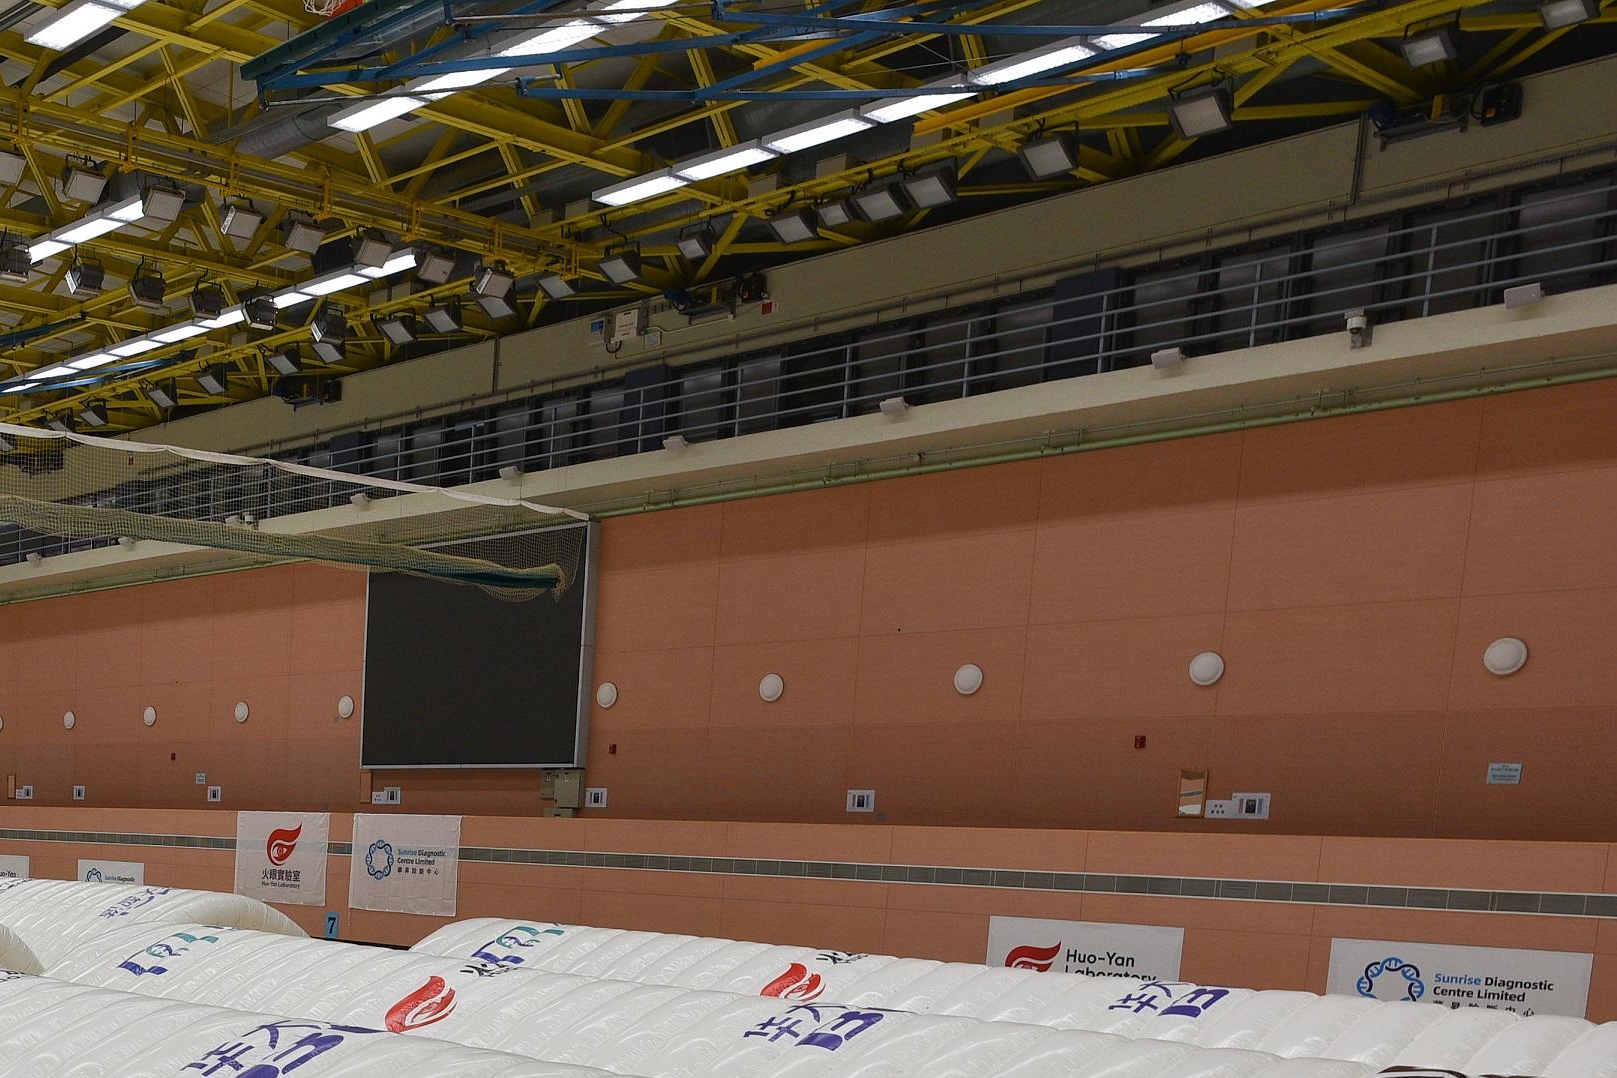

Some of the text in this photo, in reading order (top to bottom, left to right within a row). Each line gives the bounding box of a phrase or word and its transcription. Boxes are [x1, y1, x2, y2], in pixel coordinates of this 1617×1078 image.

[418, 849, 446, 858] Diagnostic
[327, 916, 337, 934] 7
[1066, 949, 1135, 967] Huo-Yan
[1434, 973, 1555, 991] Sunrise Diagnostic
[1433, 986, 1526, 1002] Centre Limited
